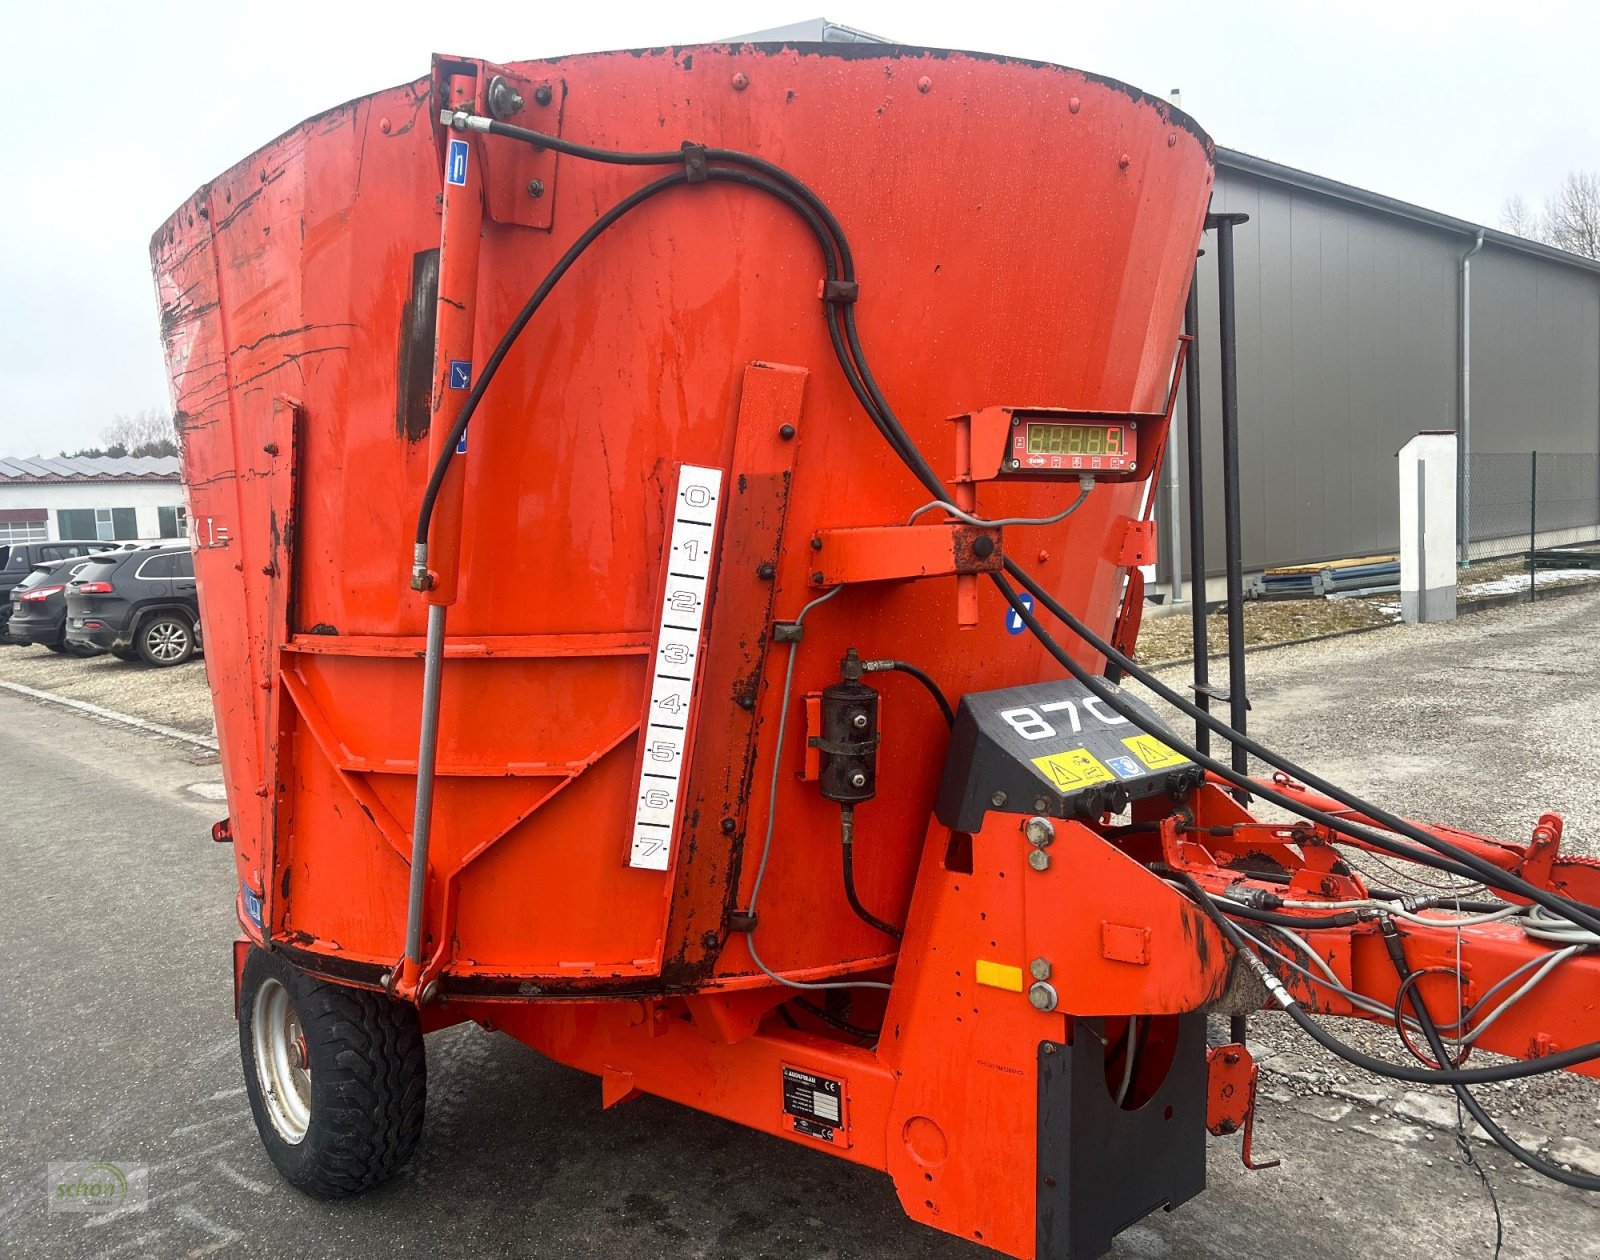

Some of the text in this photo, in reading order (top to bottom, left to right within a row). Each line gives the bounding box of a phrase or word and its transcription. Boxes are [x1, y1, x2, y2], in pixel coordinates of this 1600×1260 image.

[671, 591, 697, 613] 2
[664, 643, 689, 664] 3
[659, 693, 681, 714] 4
[651, 741, 676, 762] 5
[645, 788, 669, 809] 6
[640, 837, 664, 856] 7
